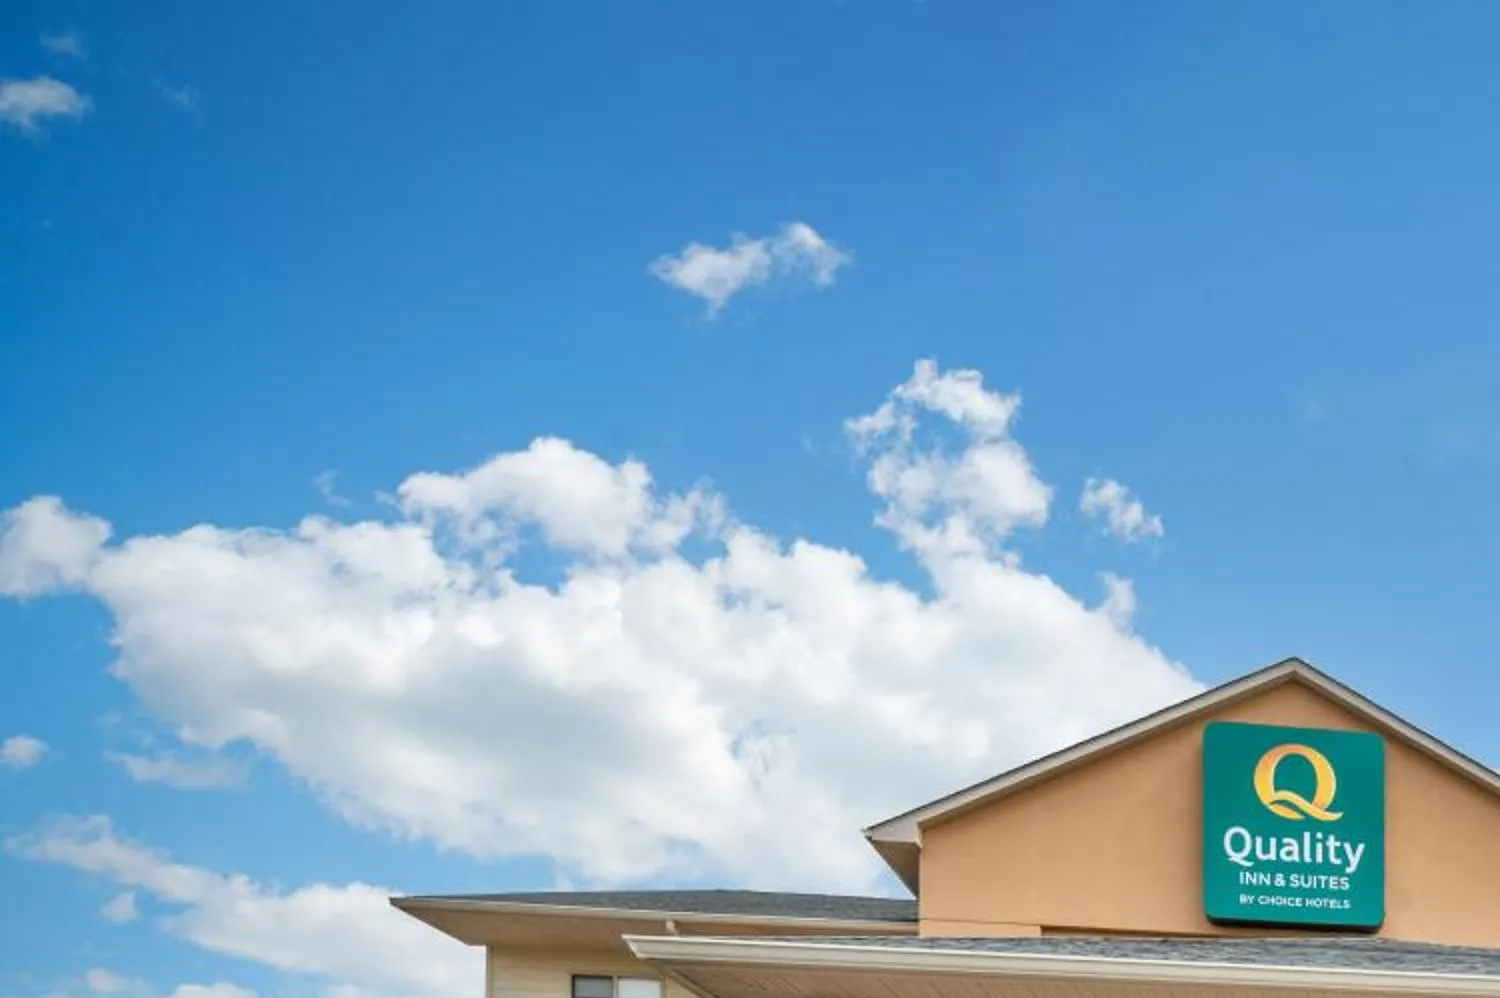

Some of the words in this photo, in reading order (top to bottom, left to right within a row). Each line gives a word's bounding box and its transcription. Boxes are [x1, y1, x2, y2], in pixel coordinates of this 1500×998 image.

[1223, 826, 1365, 873] Quality
[1239, 871, 1271, 886] INN
[1274, 873, 1285, 887] &
[1289, 875, 1350, 890] SUITES
[1239, 894, 1254, 905] BY
[1257, 895, 1302, 907] CHOICE
[1305, 898, 1351, 909] HOTELS
